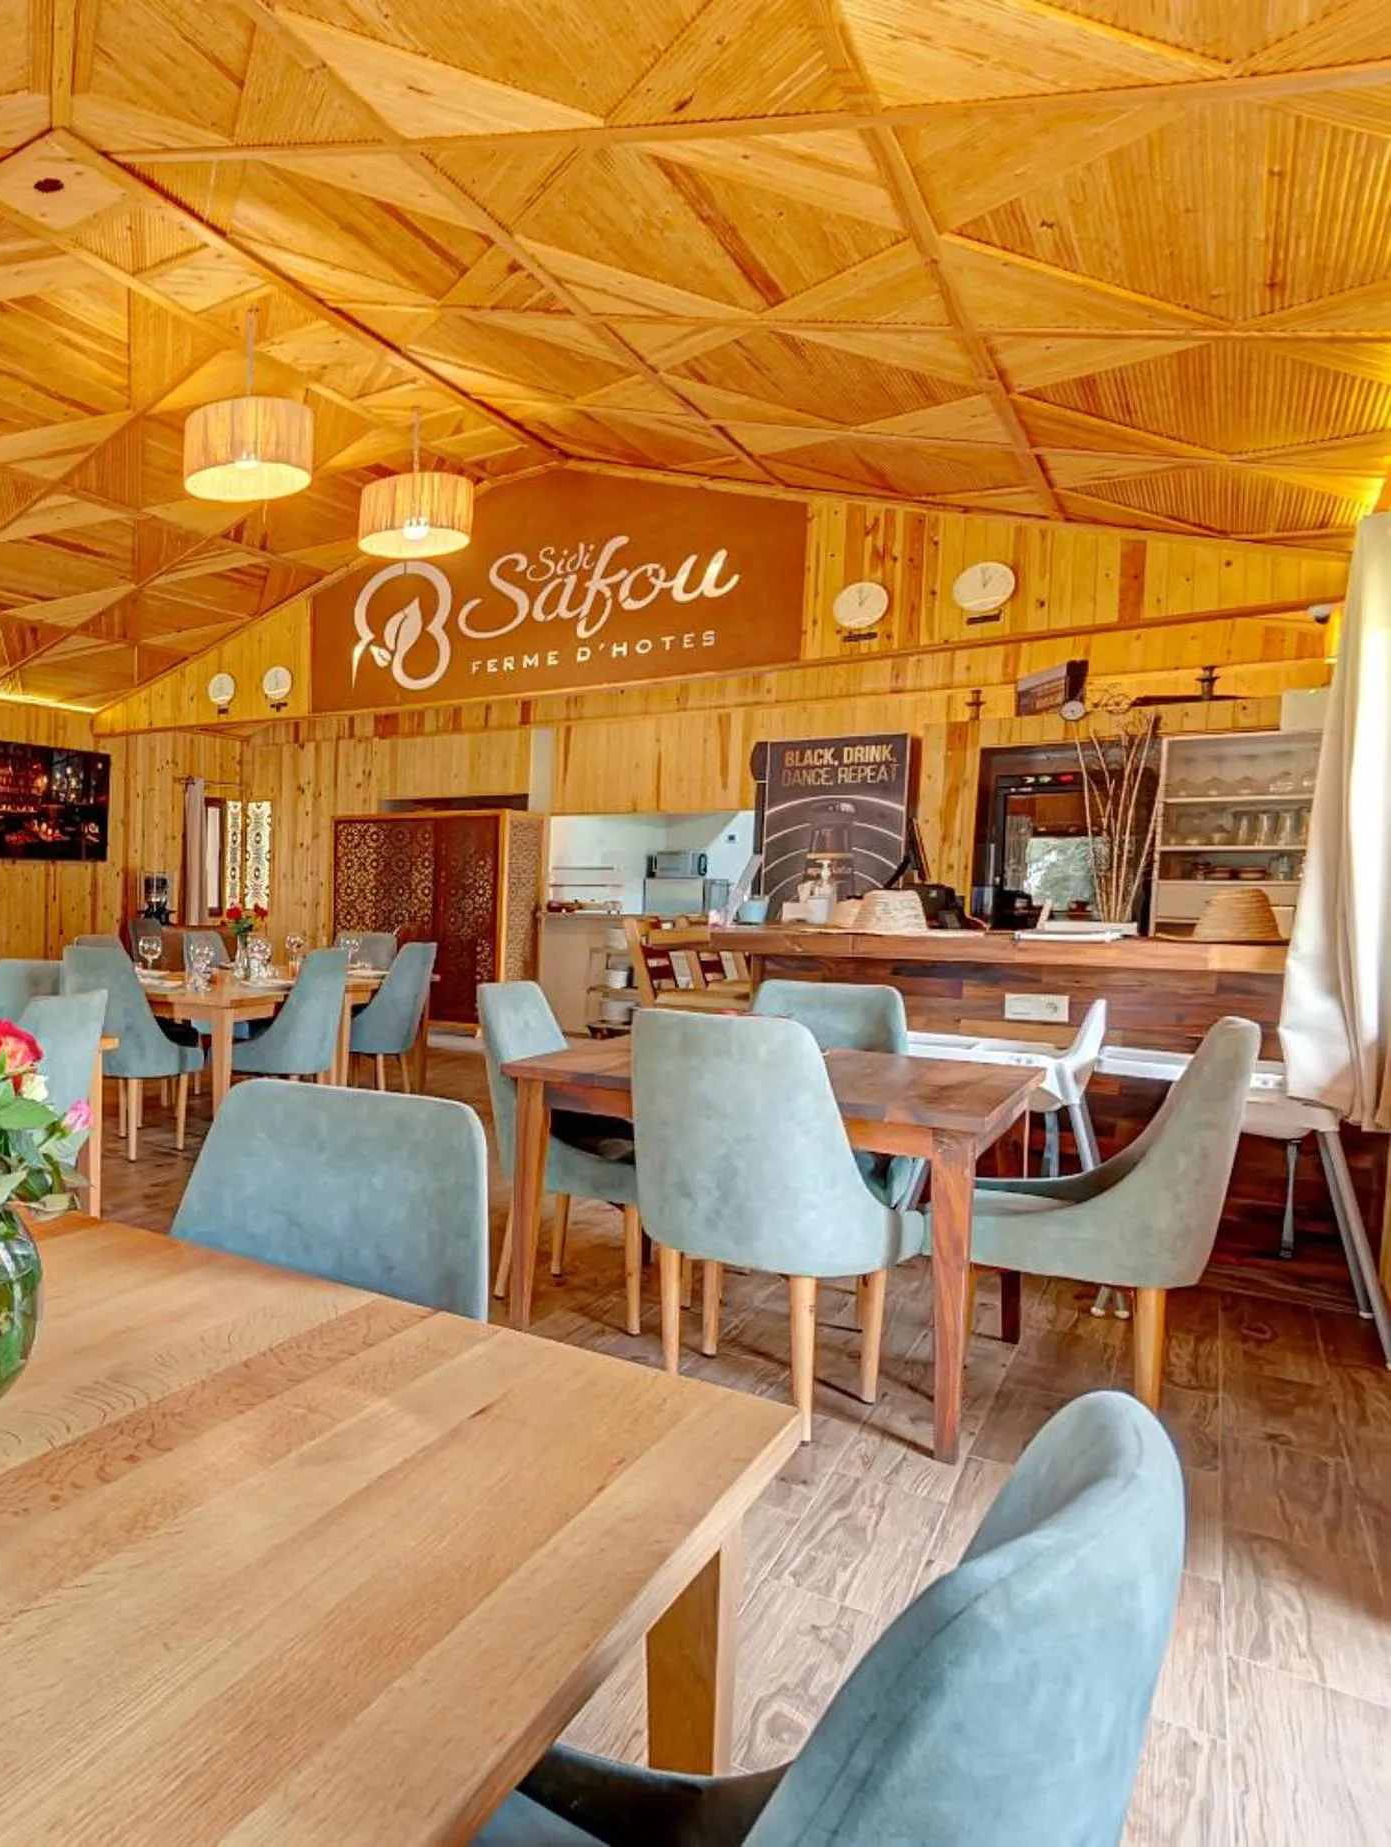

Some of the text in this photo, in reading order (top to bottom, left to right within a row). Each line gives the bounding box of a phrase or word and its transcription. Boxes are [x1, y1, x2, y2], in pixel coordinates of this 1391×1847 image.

[526, 542, 596, 582] Sidi
[457, 534, 740, 639] Safou
[471, 630, 717, 675] FERME D'HOTES
[837, 763, 901, 785] REPEAT
